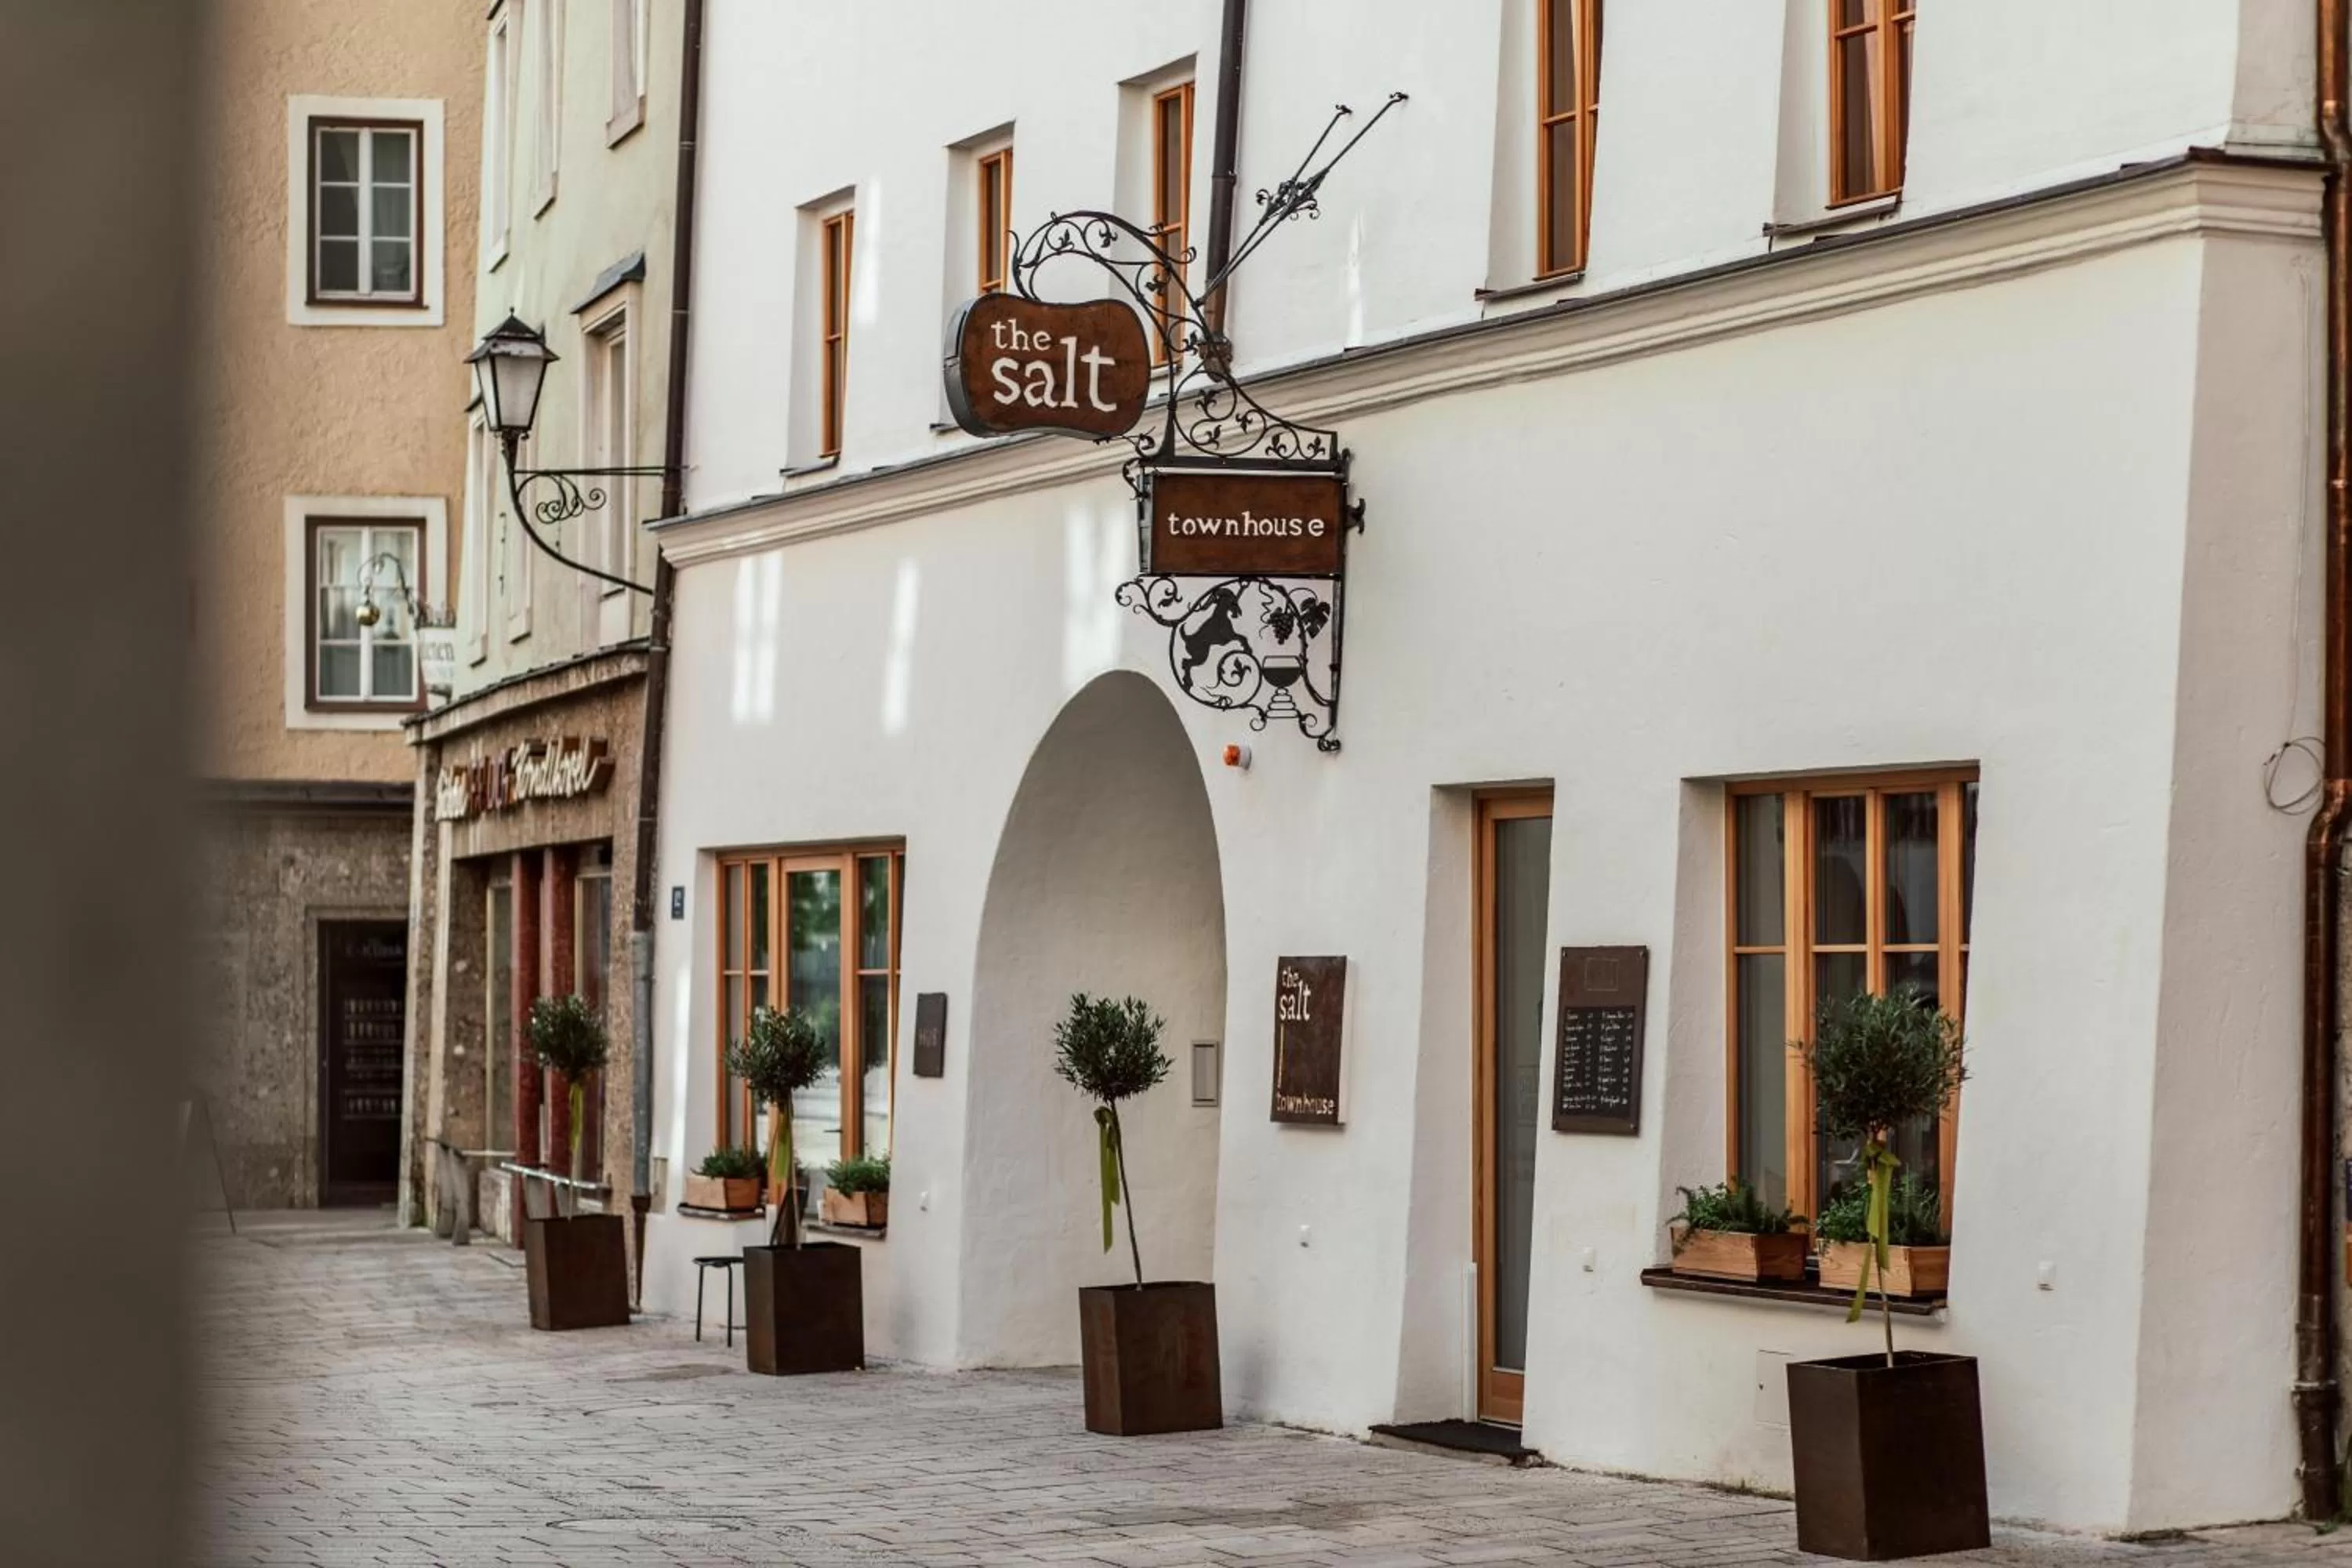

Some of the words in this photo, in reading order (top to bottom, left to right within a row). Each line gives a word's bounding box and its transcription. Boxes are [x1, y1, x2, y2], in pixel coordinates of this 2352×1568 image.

[990, 318, 1052, 351] the
[991, 336, 1118, 413] salt
[1168, 510, 1325, 538] townhouse
[1281, 965, 1300, 989] the
[1279, 980, 1312, 1022] salt
[1276, 1091, 1335, 1116] townhouse
